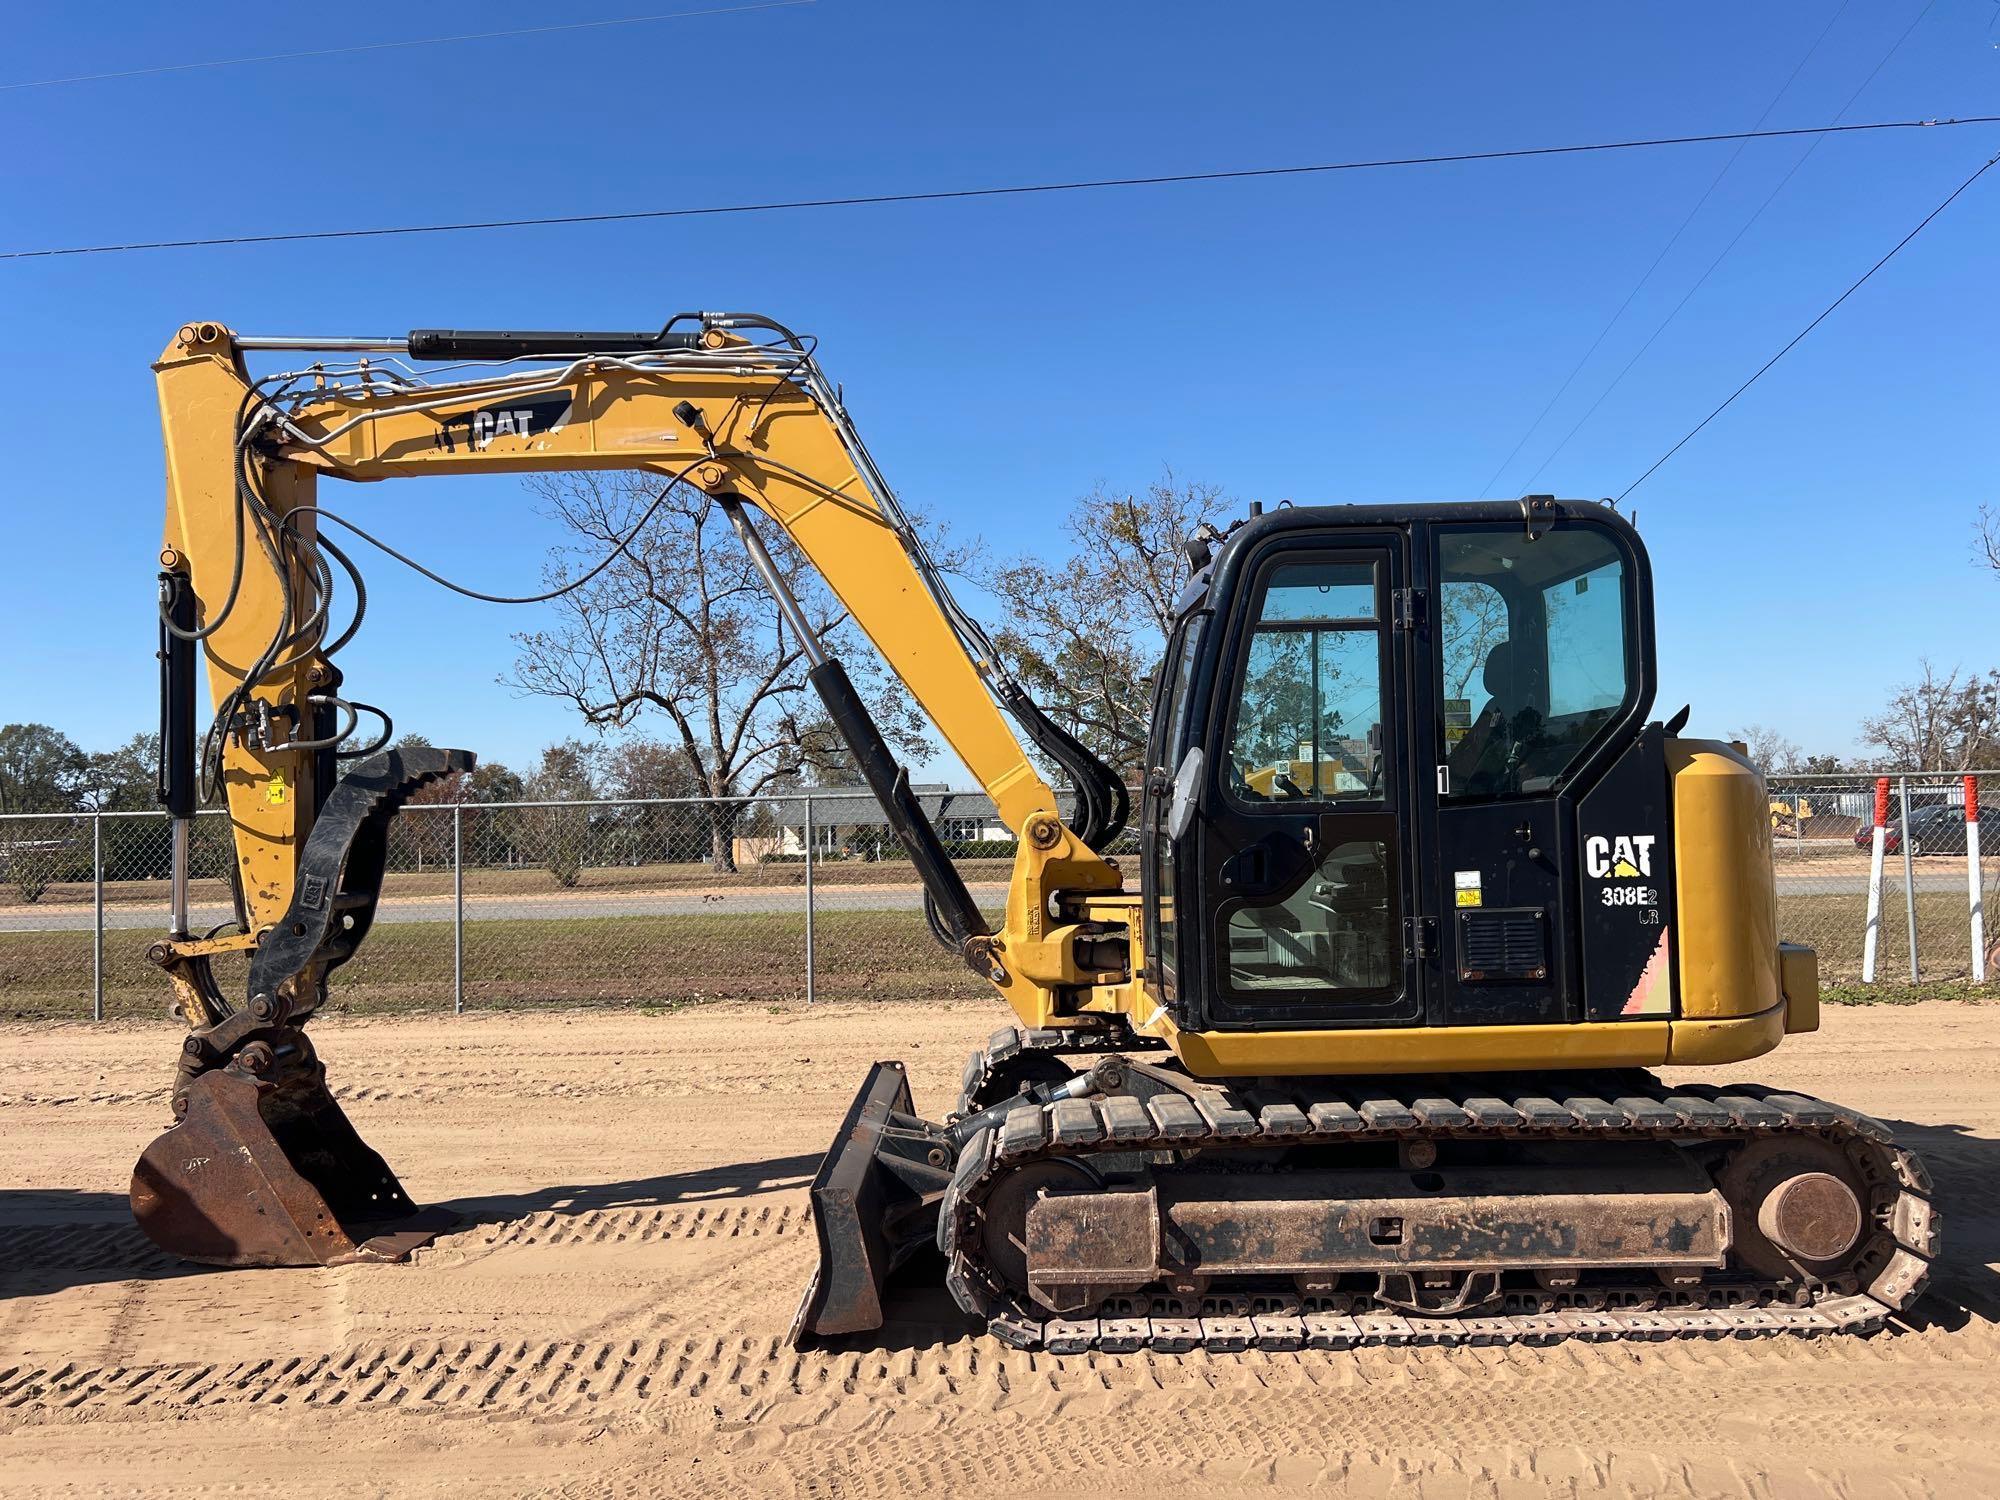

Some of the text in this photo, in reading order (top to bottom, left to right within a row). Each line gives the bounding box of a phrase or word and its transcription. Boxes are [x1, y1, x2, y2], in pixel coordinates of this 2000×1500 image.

[474, 410, 533, 449] CAT
[1586, 835, 1655, 878] CAT
[1601, 886, 1657, 906] 308E2
